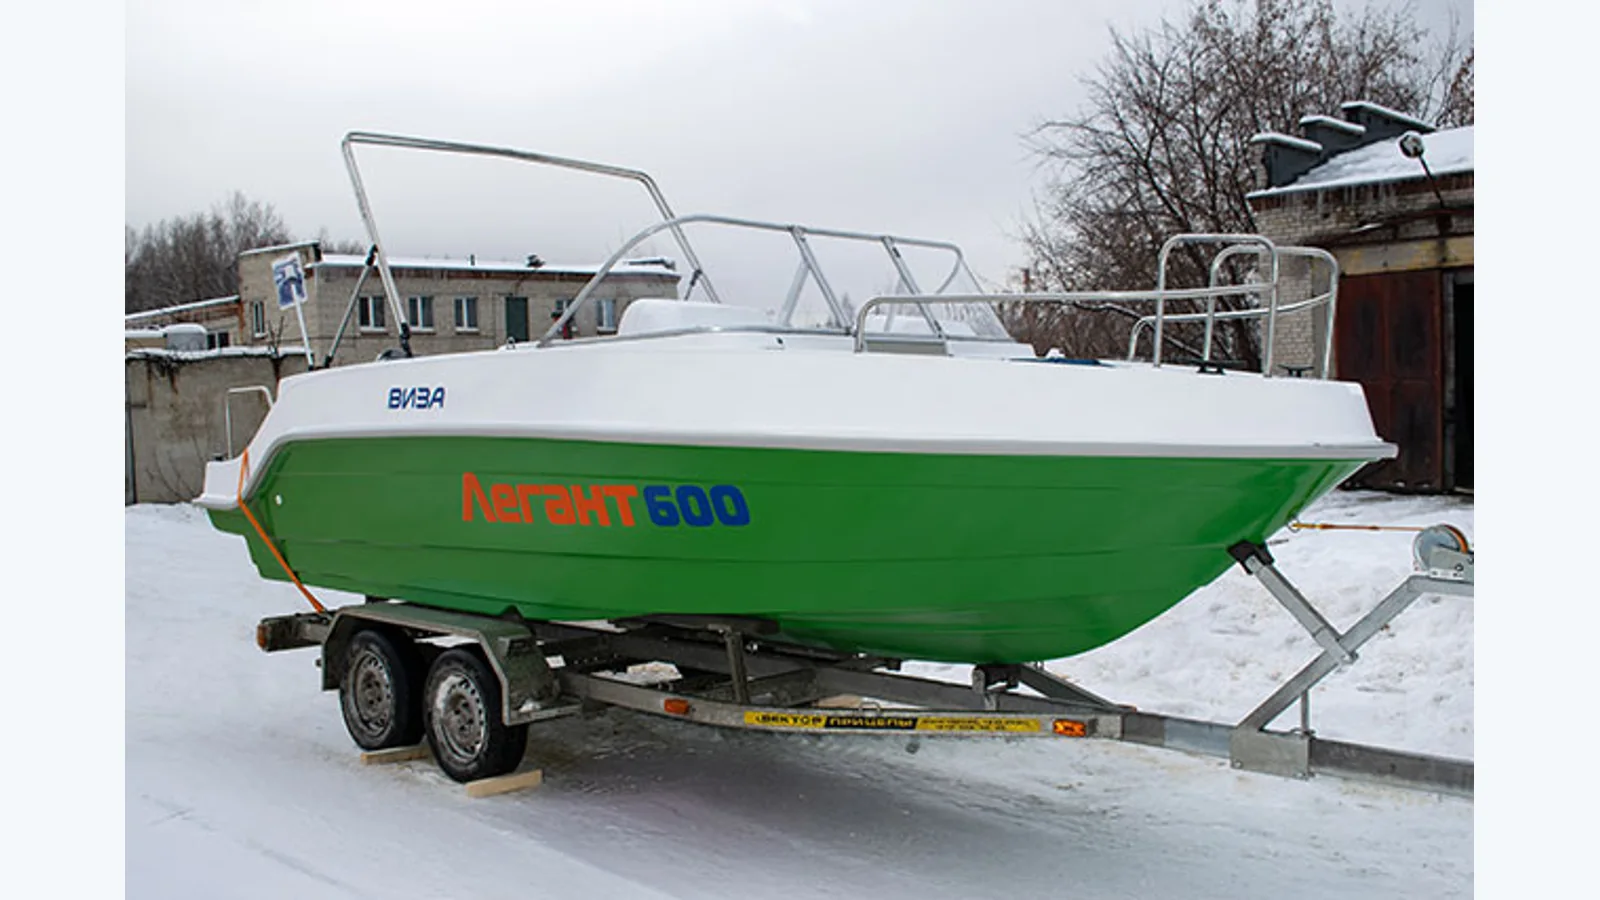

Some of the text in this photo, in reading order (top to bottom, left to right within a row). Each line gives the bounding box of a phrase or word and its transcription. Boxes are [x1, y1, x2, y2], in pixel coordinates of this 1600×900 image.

[388, 387, 445, 409] ВИЗА
[461, 472, 751, 526] Легант 600
